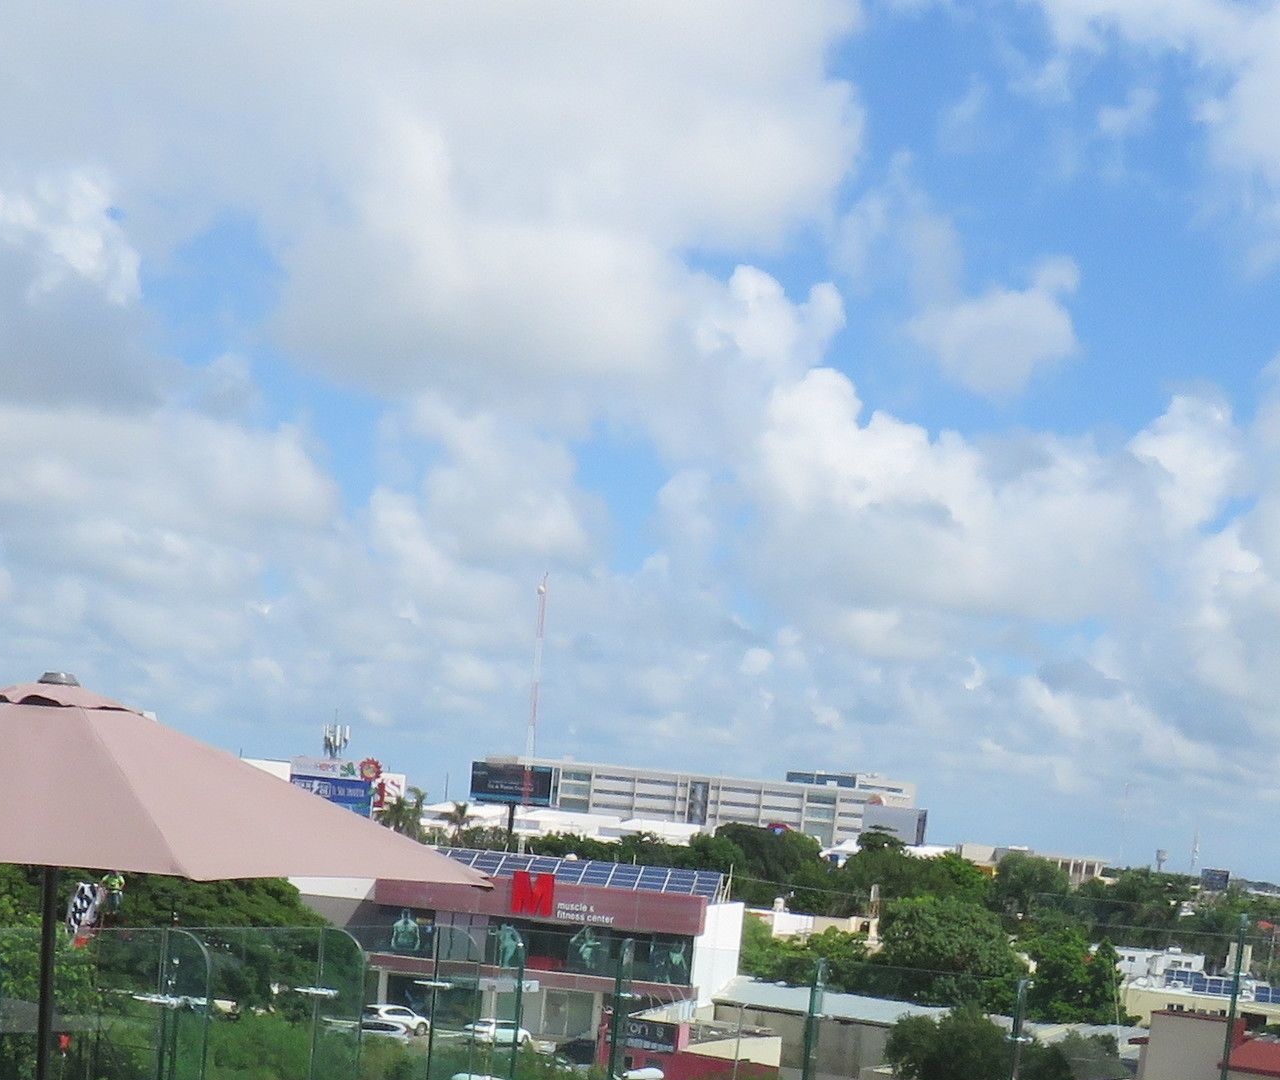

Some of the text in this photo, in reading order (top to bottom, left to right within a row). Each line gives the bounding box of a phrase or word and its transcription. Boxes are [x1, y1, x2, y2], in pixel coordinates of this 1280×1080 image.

[511, 870, 555, 917] M
[557, 902, 588, 912] muscle
[557, 910, 614, 924] fitness center
